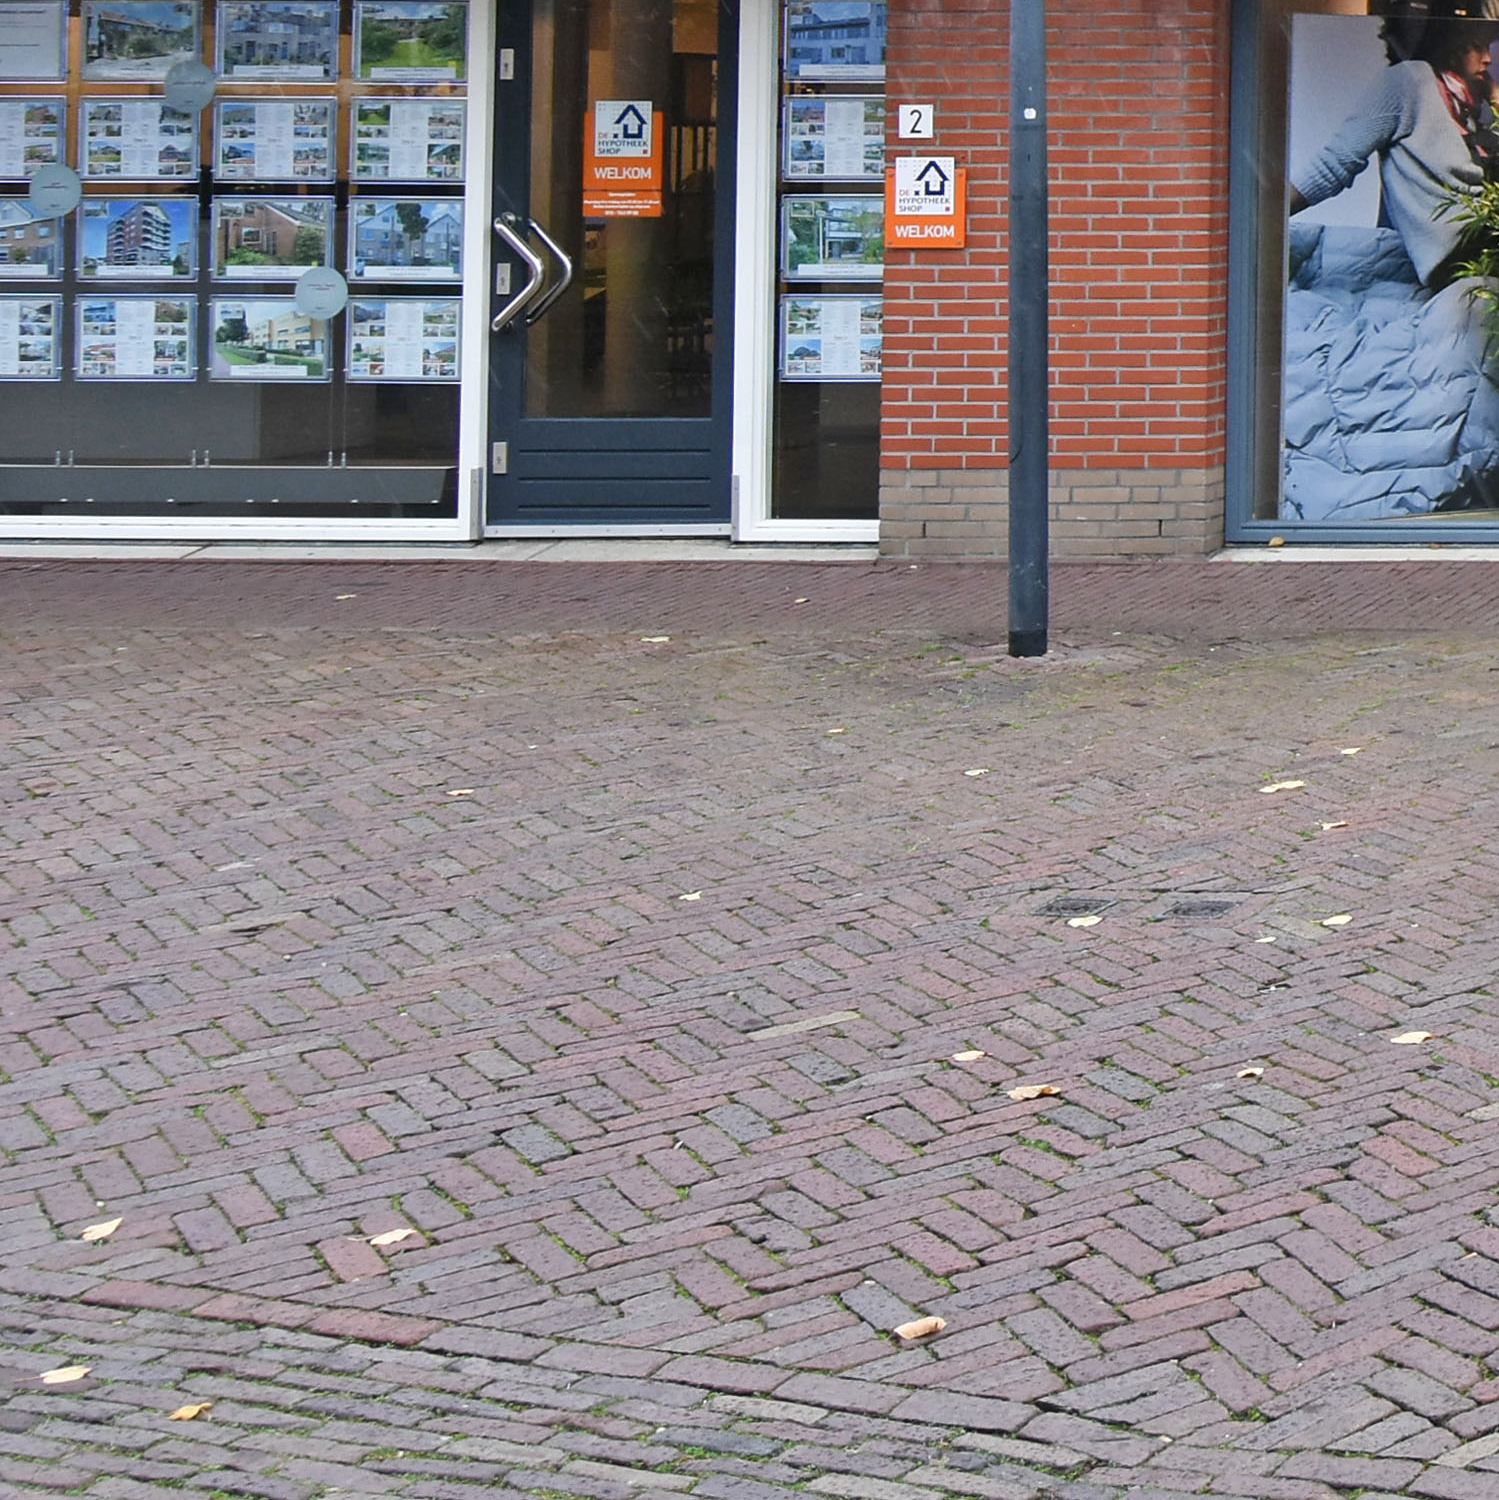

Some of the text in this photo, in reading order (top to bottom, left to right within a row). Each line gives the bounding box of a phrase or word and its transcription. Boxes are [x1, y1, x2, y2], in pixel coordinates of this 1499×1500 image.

[910, 109, 922, 134] 2
[598, 147, 621, 155] SHOP
[594, 166, 652, 180] WELKOM
[899, 197, 951, 205] HYPOTHEEK
[895, 224, 955, 238] WELKOM
